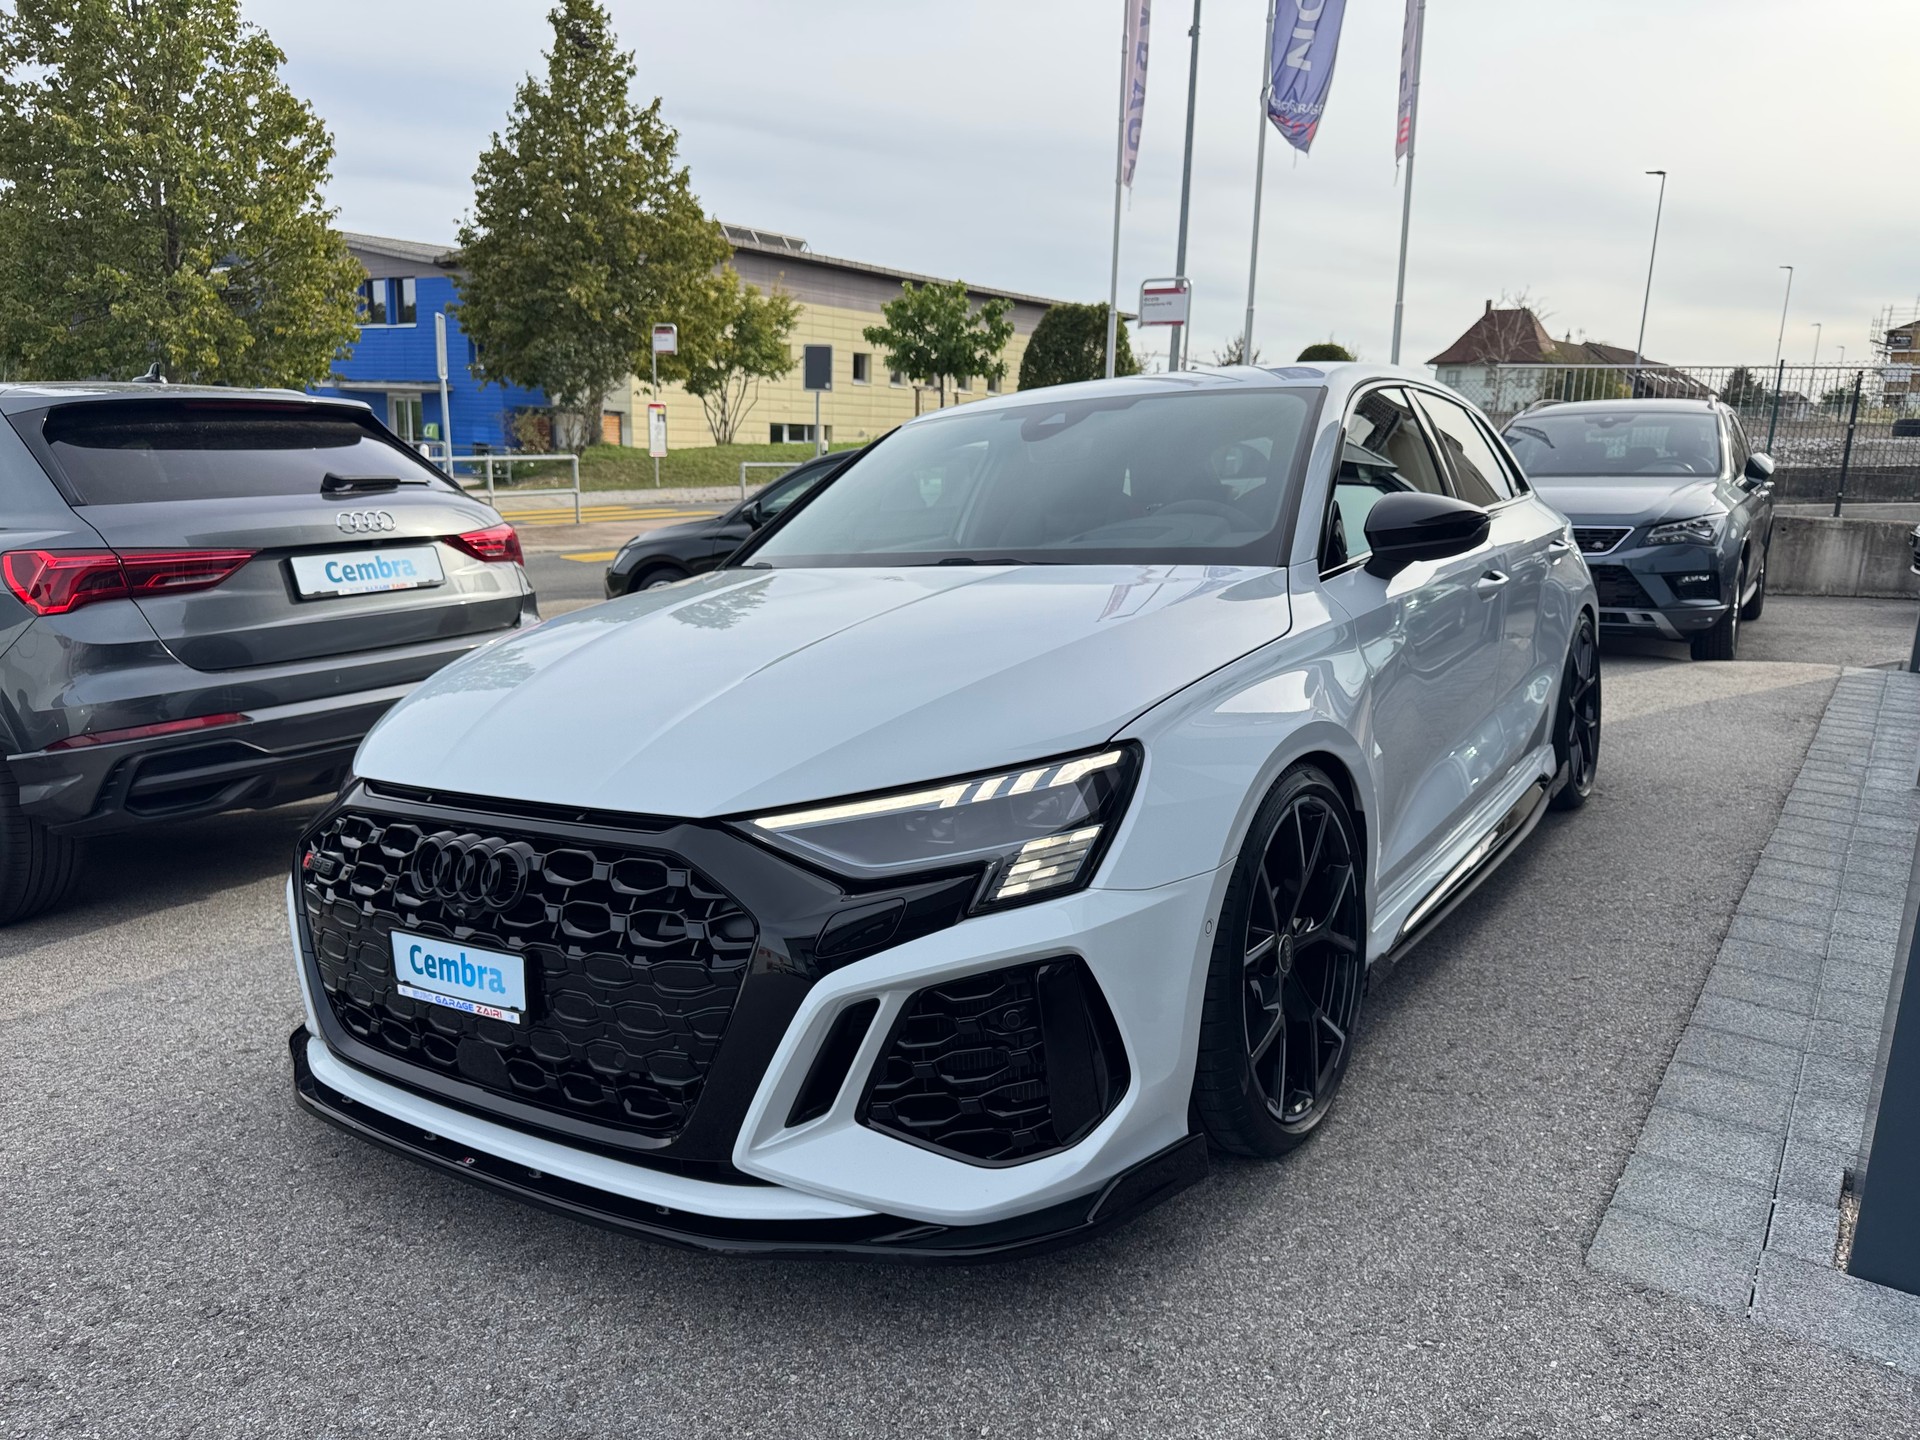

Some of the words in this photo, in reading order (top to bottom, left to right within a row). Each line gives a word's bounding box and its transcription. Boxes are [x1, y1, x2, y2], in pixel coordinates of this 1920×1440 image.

[325, 555, 417, 583] Cembra
[410, 944, 506, 994] Cembra
[434, 995, 475, 1012] GARAGE
[476, 1005, 503, 1019] ZAIRI
